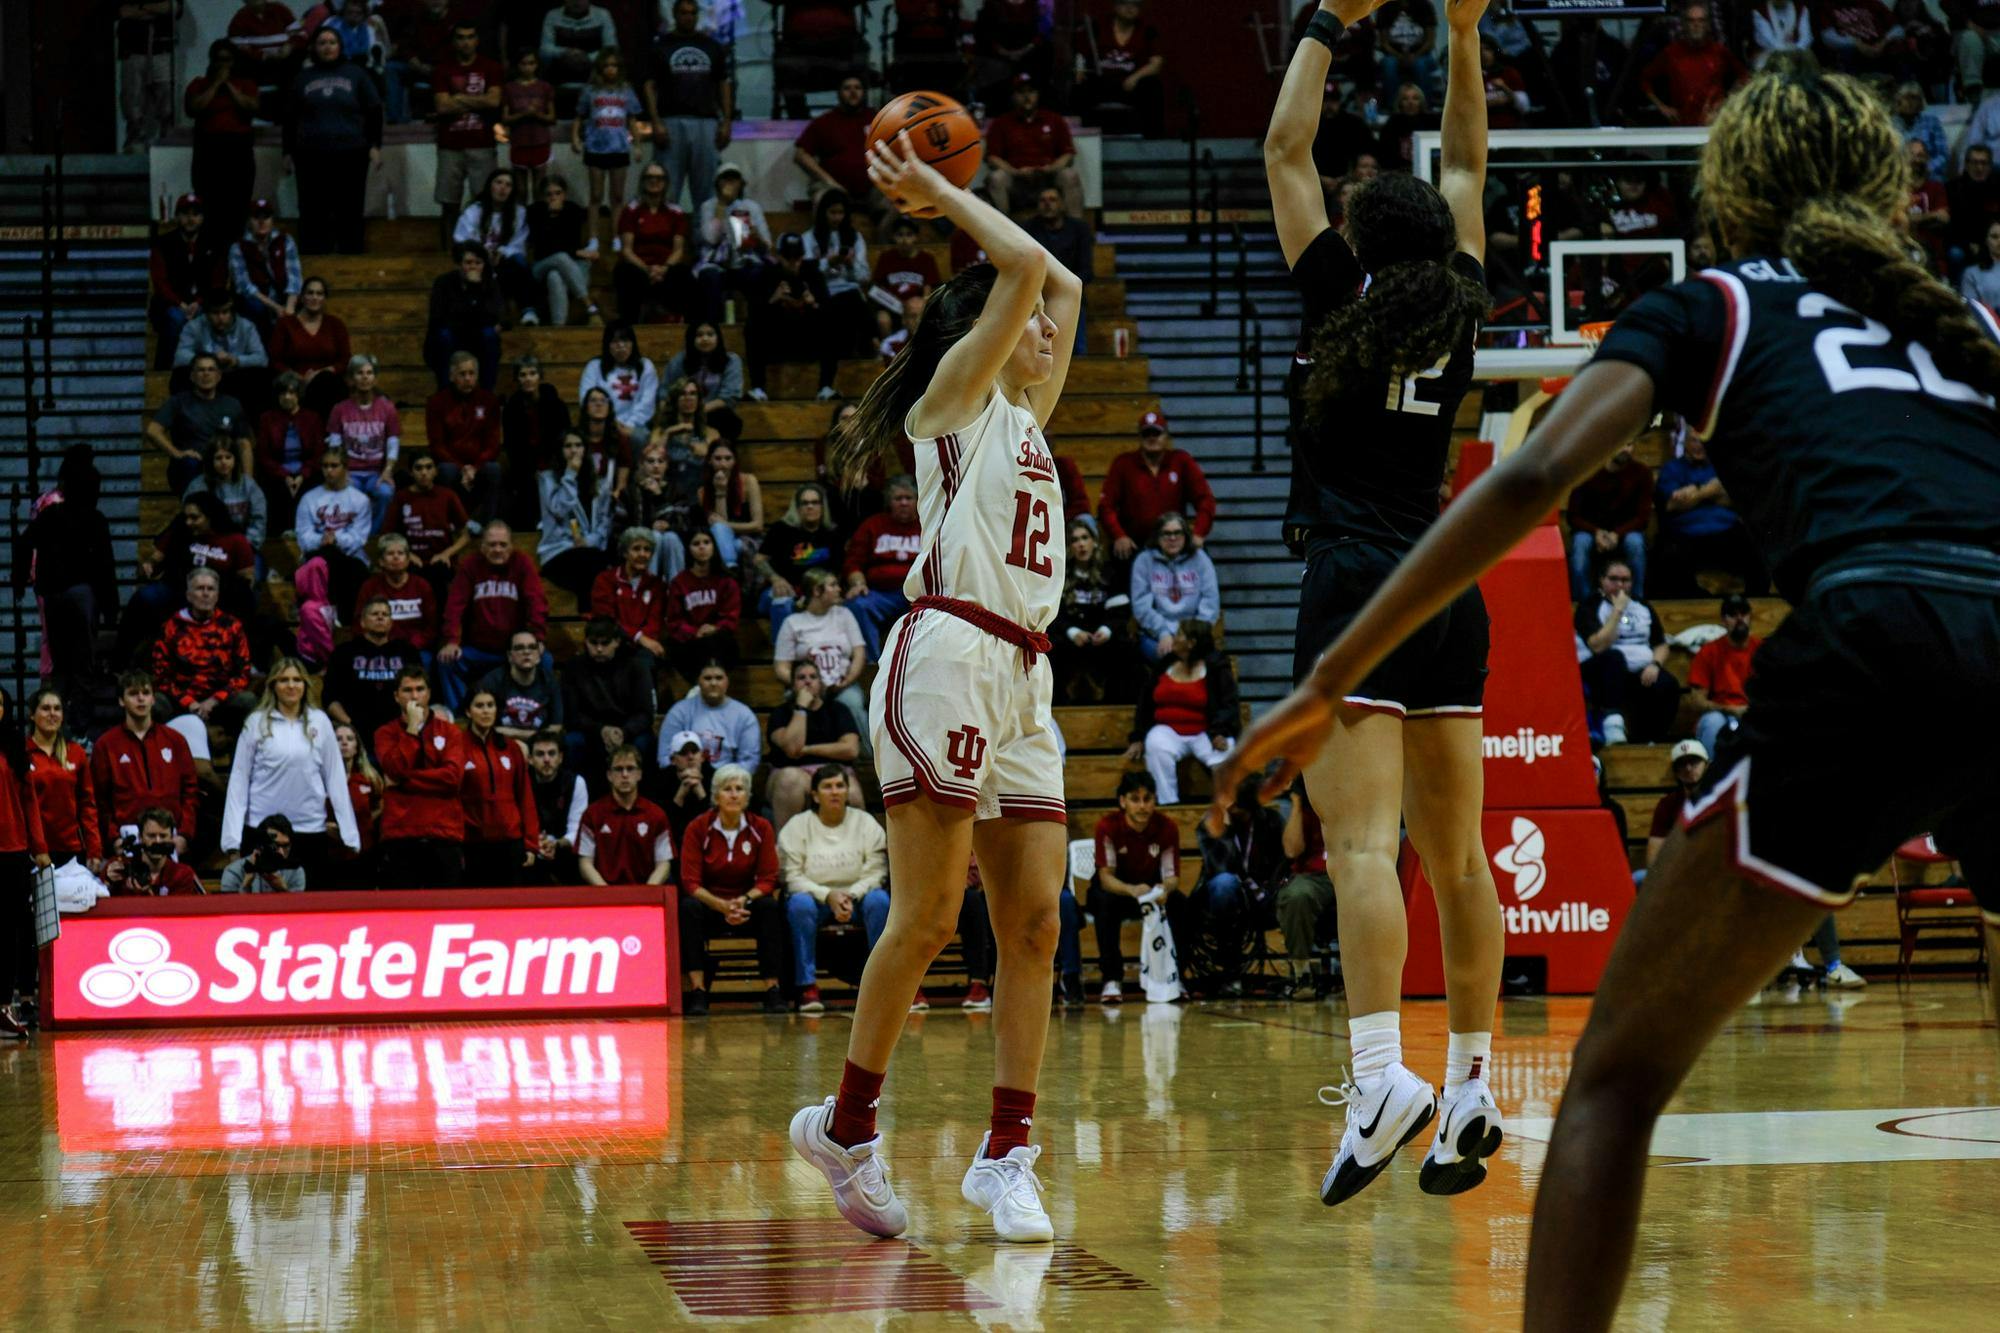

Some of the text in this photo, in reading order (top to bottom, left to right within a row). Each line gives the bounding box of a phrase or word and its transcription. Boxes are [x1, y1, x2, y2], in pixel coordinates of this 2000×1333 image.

[1005, 490, 1053, 578] 12
[946, 724, 987, 780] IU
[1482, 727, 1564, 764] meijer
